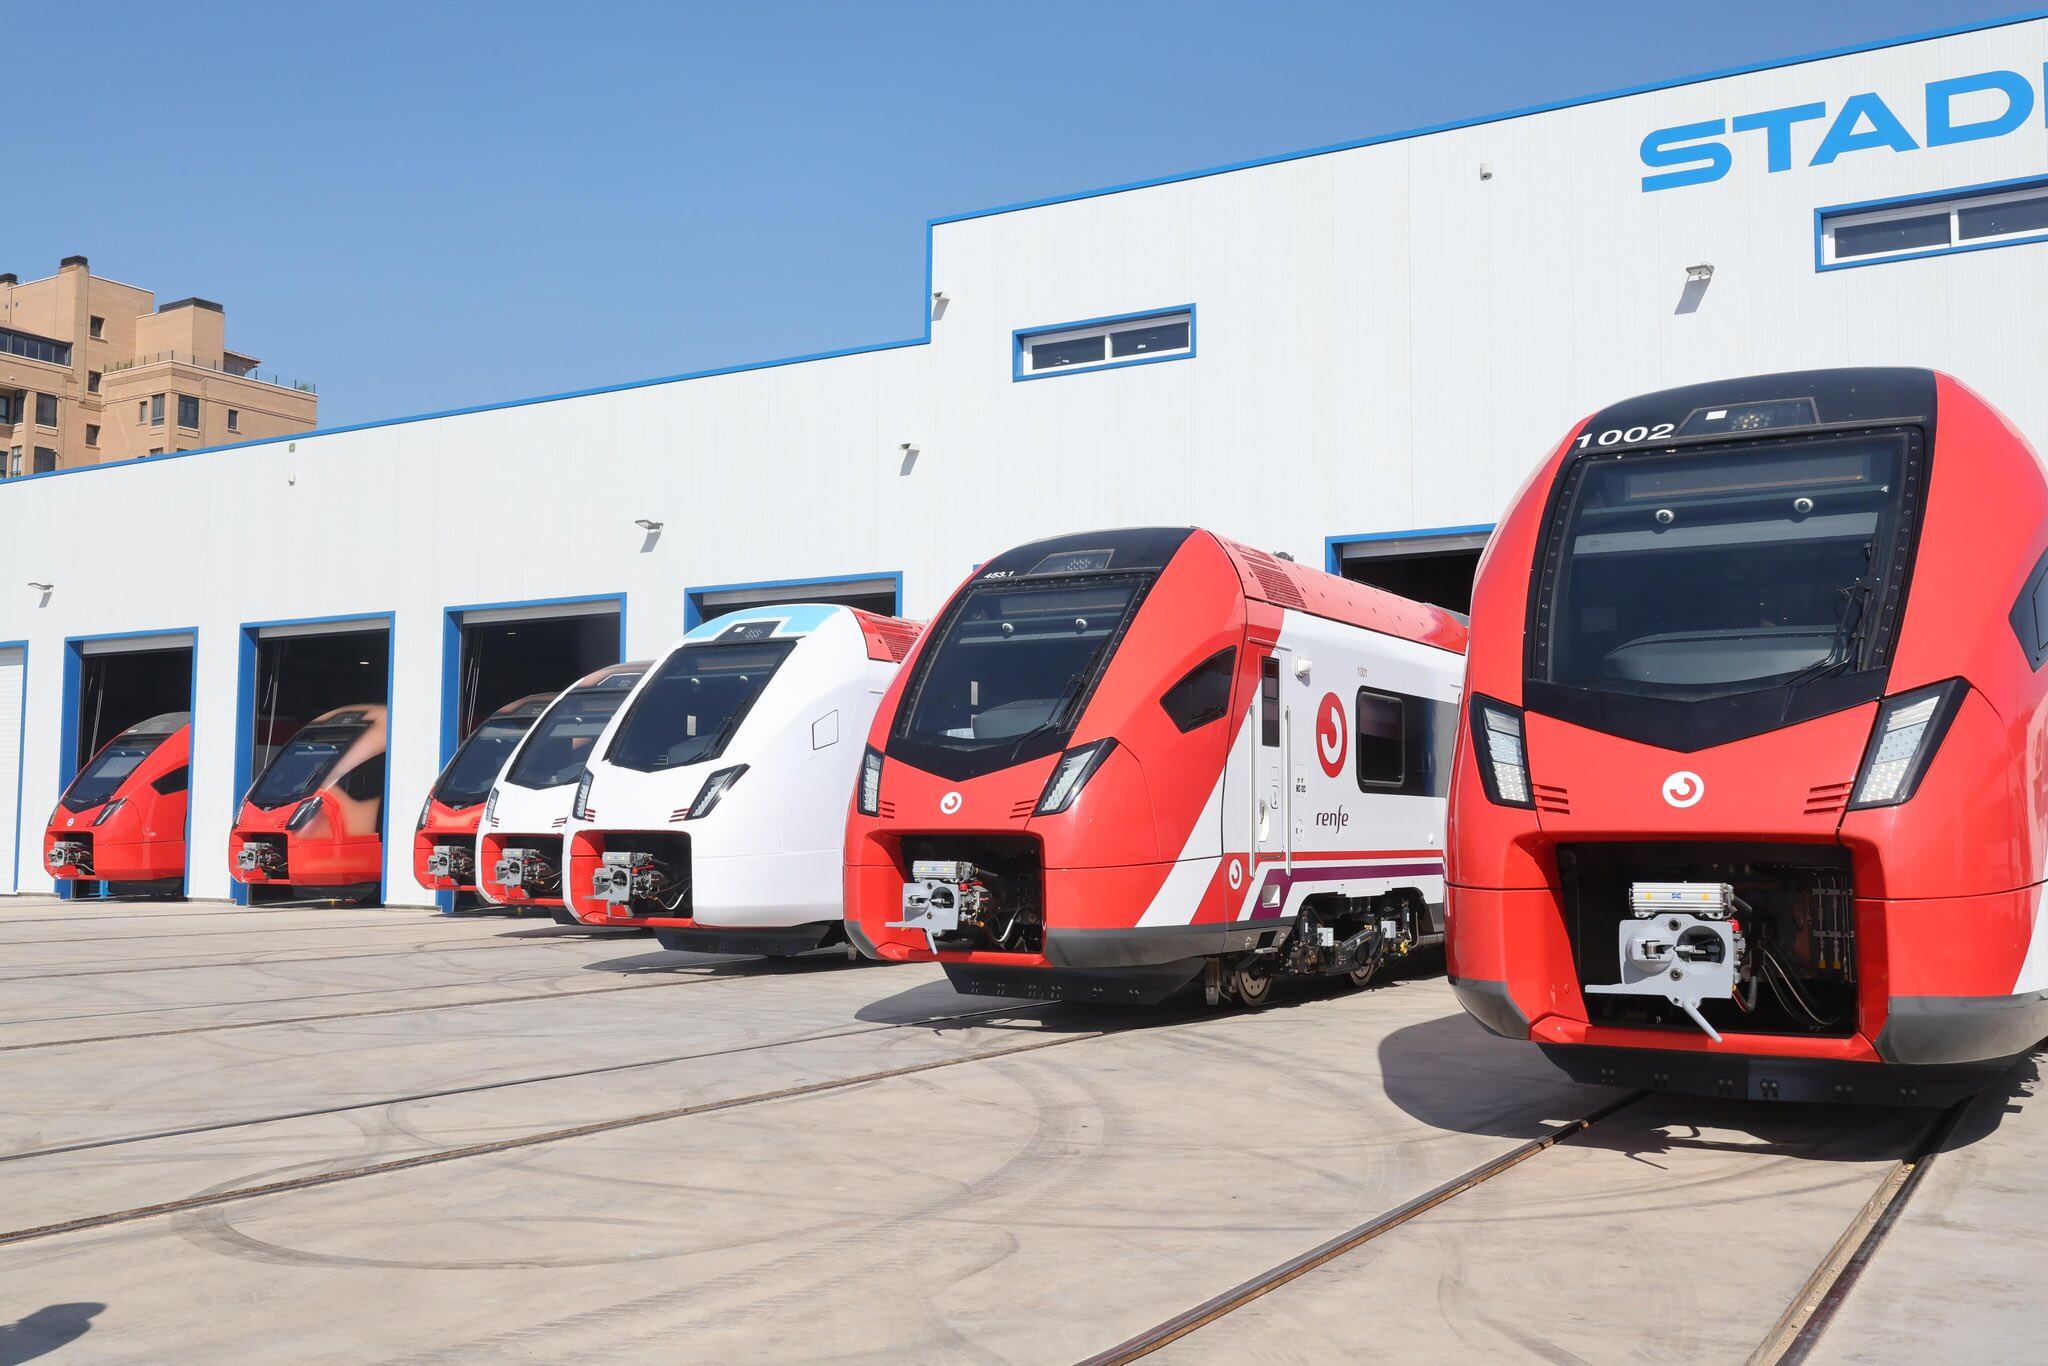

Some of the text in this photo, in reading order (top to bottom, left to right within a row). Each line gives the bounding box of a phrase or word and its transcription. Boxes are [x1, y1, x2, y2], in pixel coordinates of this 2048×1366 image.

[1640, 62, 2048, 193] STAD
[1576, 423, 1675, 449] 1002
[1316, 804, 1349, 834] renfe
